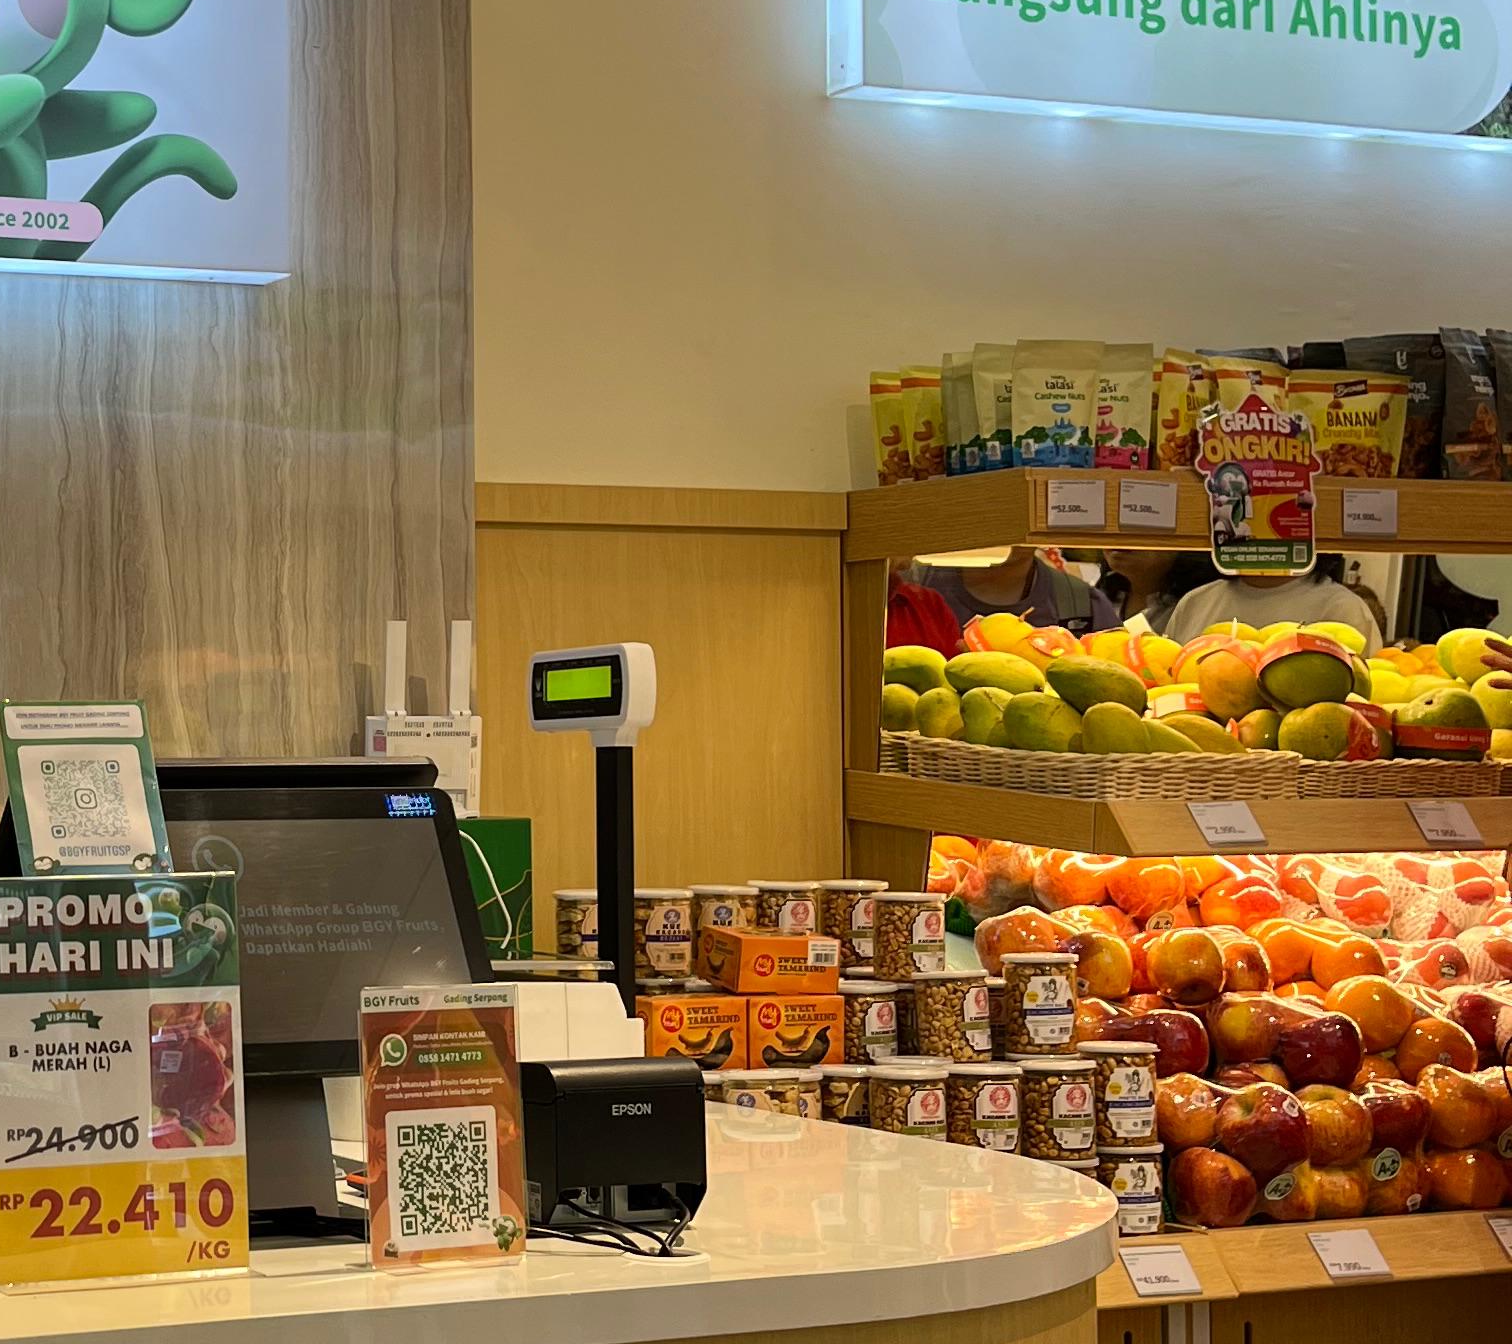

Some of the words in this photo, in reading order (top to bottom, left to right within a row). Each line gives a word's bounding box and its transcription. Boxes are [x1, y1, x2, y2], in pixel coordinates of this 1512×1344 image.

[22, 210, 70, 231] 2002
[1220, 412, 1291, 434] GRATIS
[1204, 434, 1310, 465] ONGKIR!
[59, 844, 131, 857] @BGYFRUITGSP
[240, 905, 268, 918] Jadi
[272, 904, 329, 917] Member
[332, 903, 343, 916] &
[346, 904, 400, 918] Gabung
[241, 920, 313, 937] WhatsApp
[316, 921, 359, 936] Group
[362, 920, 393, 934] BGY
[245, 939, 315, 955] Dapatkan
[317, 937, 372, 953] Hadiah!
[0, 939, 101, 974] HARI
[116, 937, 174, 970] INI
[777, 964, 827, 974] TAMARIND
[364, 996, 387, 1007] BGY
[388, 994, 420, 1007] Fruits
[443, 993, 473, 1005] Gading
[473, 992, 508, 1004] Serpong
[686, 1006, 720, 1015] SWEET
[784, 1004, 817, 1013] SWEET
[45, 1012, 63, 1022] VIP
[63, 1011, 88, 1021] SALE
[687, 1014, 741, 1025] TAMARIND
[784, 1013, 838, 1023] TAMARIND
[8, 1045, 19, 1058] B
[35, 1042, 79, 1057] BUAH
[85, 1040, 133, 1054] NAGA
[439, 1052, 460, 1062] 1471
[461, 1051, 482, 1061] 4773
[32, 1057, 88, 1072] MERAH
[93, 1056, 111, 1072] (L)
[611, 1103, 652, 1117] EPSON
[186, 1240, 231, 1263] /KG
